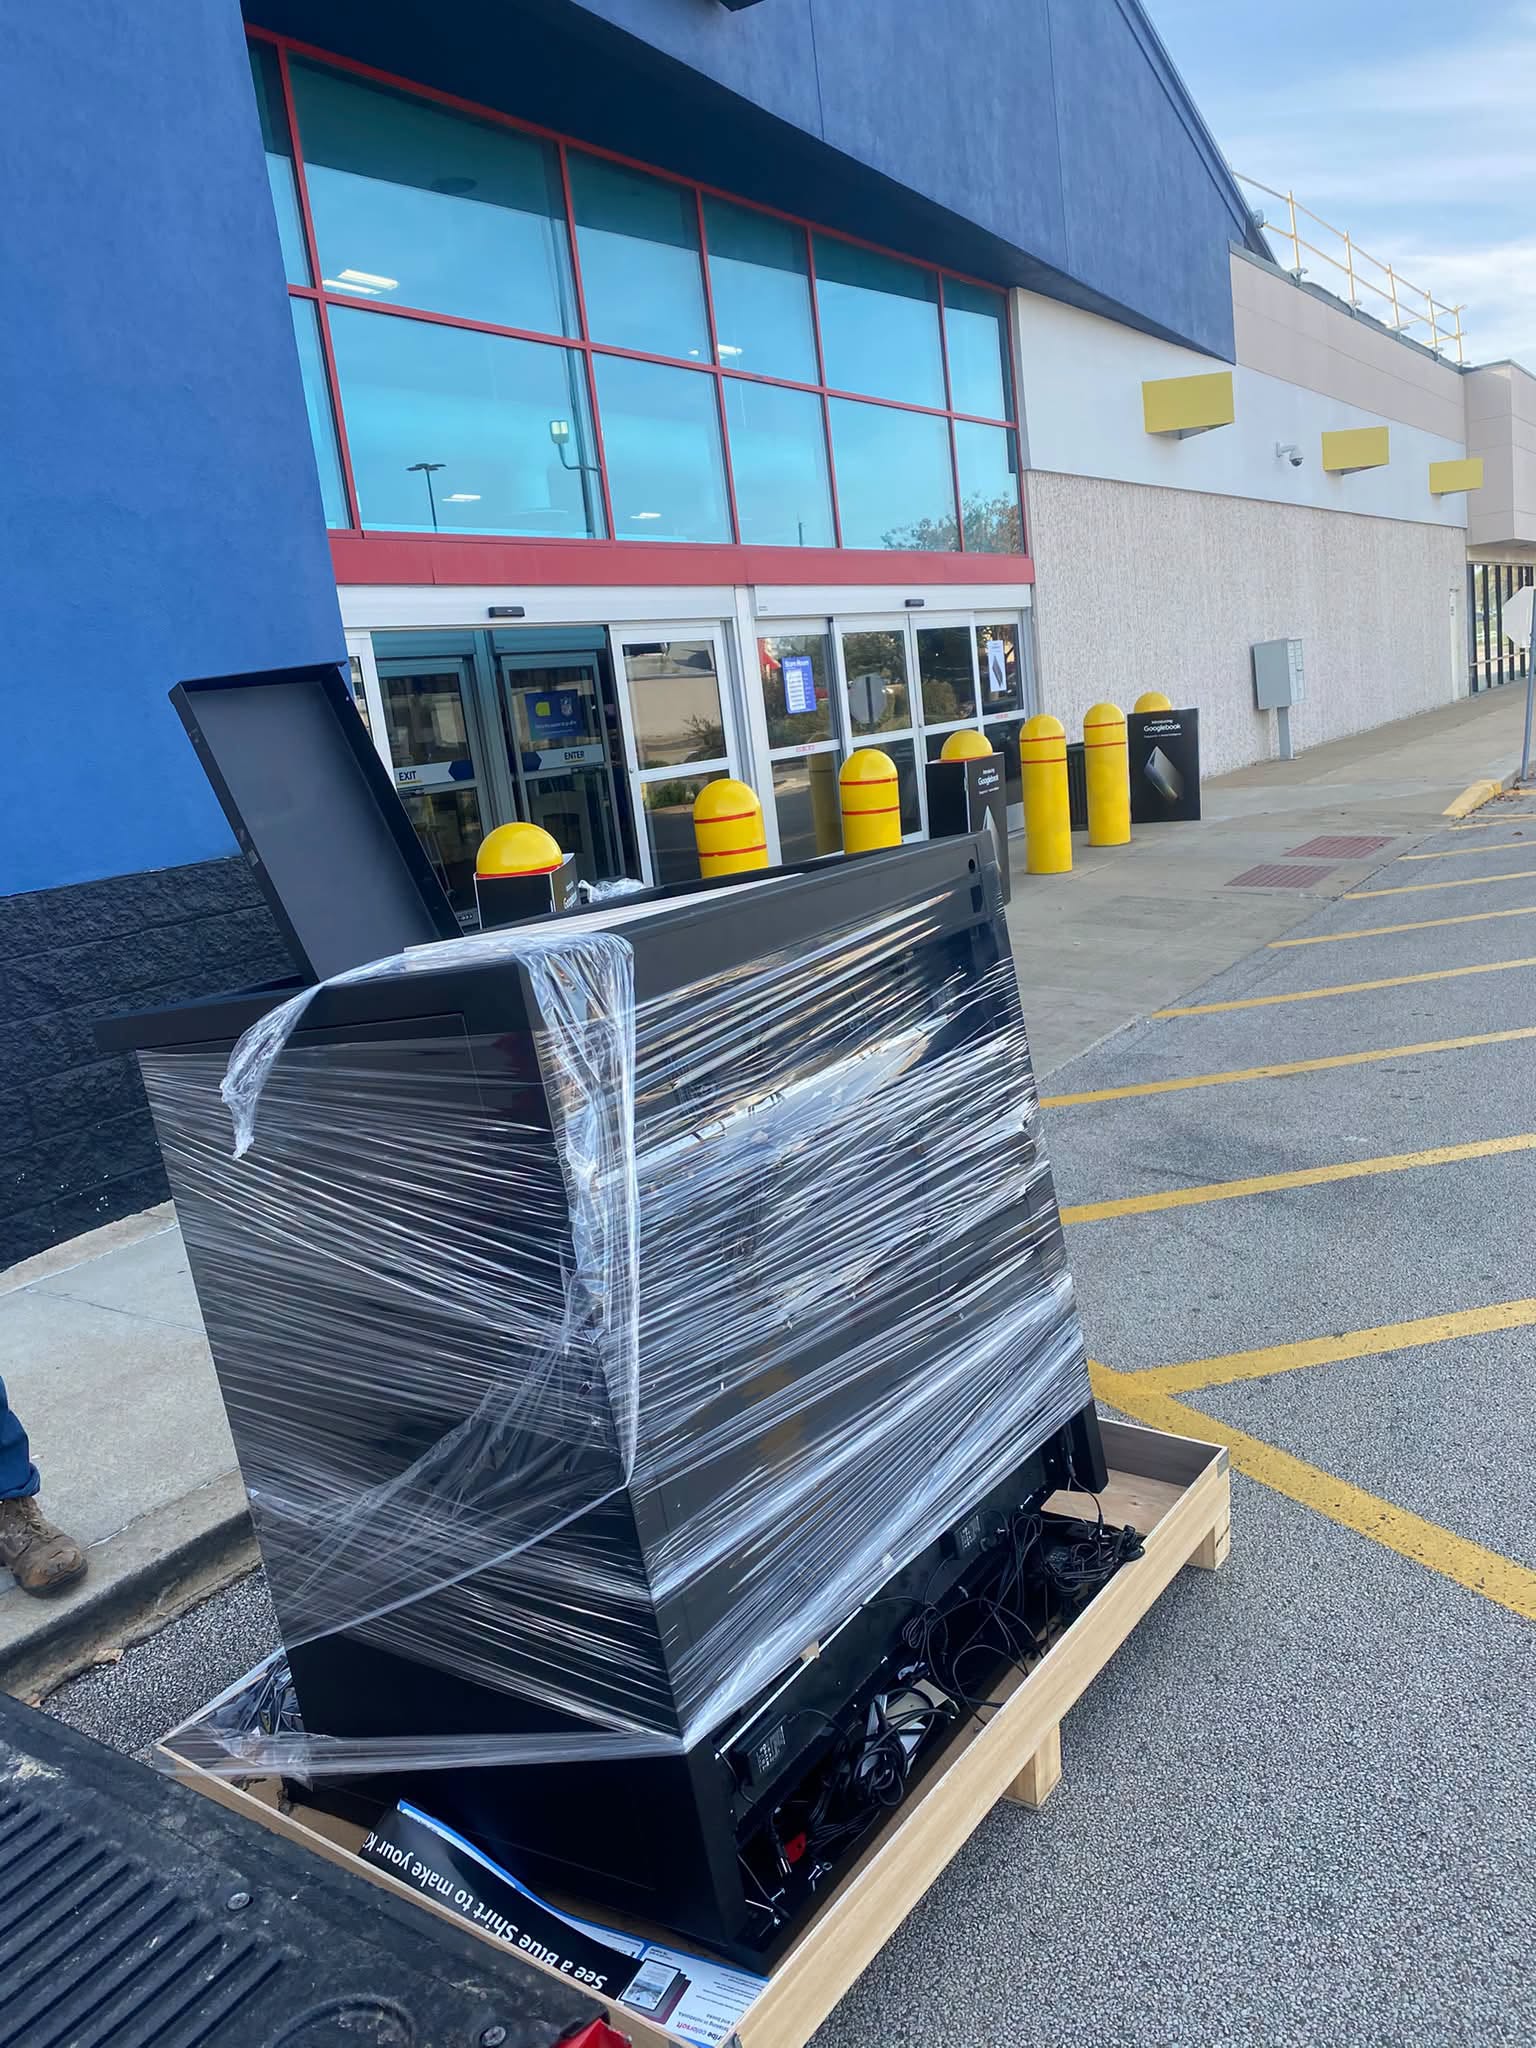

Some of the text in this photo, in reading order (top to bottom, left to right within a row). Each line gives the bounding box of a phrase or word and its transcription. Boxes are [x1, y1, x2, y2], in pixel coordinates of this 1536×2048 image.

[1143, 723, 1181, 733] Googlebook
[564, 750, 585, 761] ENTER
[398, 770, 417, 781] EXIT
[376, 1840, 415, 1870] your
[411, 1861, 455, 1896] make
[454, 1889, 474, 1912] to
[473, 1902, 519, 1942] Shirt
[518, 1934, 560, 1967] Blue
[560, 1960, 573, 1973] a
[574, 1966, 608, 1990] See
[676, 2021, 708, 2036] colorsoft
